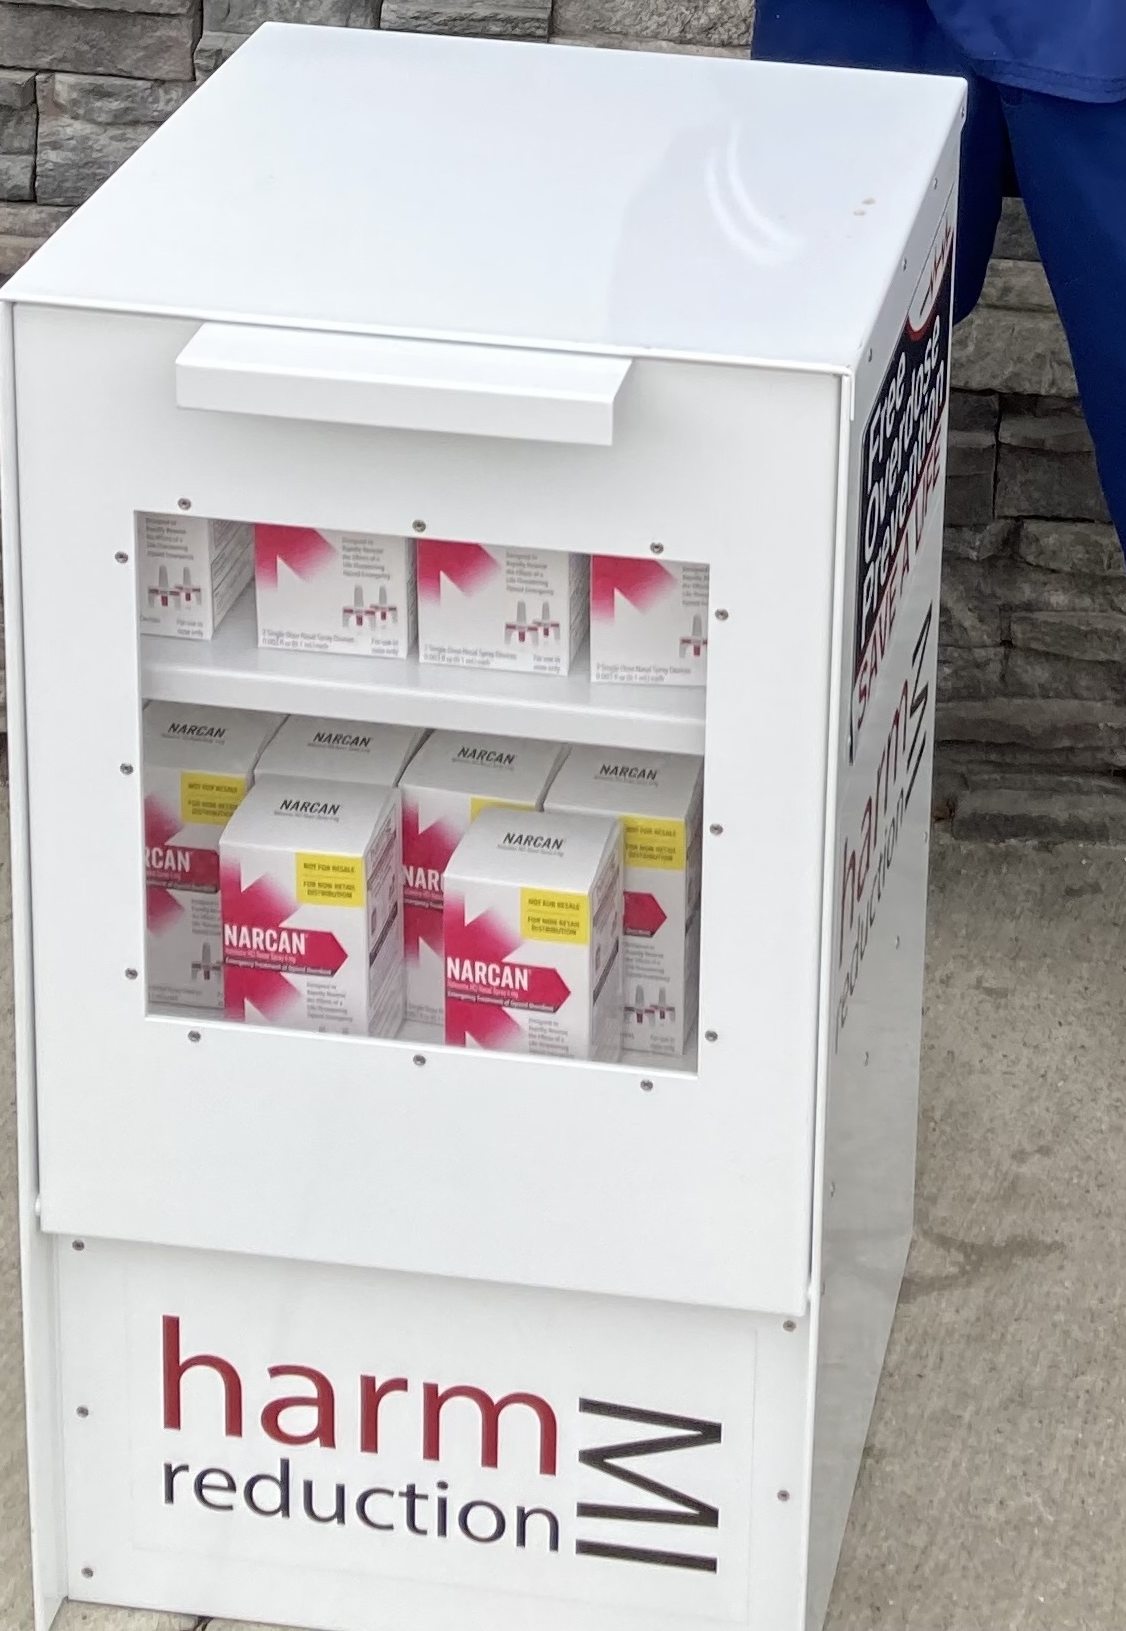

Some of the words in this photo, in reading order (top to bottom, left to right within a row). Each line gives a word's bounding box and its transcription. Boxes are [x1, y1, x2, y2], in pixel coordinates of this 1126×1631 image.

[864, 312, 941, 564] Overdose
[867, 350, 906, 495] Free
[861, 359, 945, 651] Prevention
[857, 573, 897, 729] SAVE
[900, 529, 910, 600] A
[915, 420, 941, 557] LIFE
[168, 722, 225, 738] NARCAN
[313, 732, 371, 747] NARCAN
[457, 746, 515, 764] NARCAN
[599, 764, 657, 781] NARCAN
[280, 798, 340, 815] NARCAN
[838, 676, 908, 970] harm
[503, 832, 565, 852] NARCAN
[402, 865, 444, 892] NAR
[224, 923, 306, 955] NARCAN
[834, 785, 904, 1054] reduction
[447, 956, 529, 991] NARCAN
[162, 1314, 558, 1476] harm
[162, 1457, 561, 1554] reduction
[574, 1396, 723, 1575] MI
